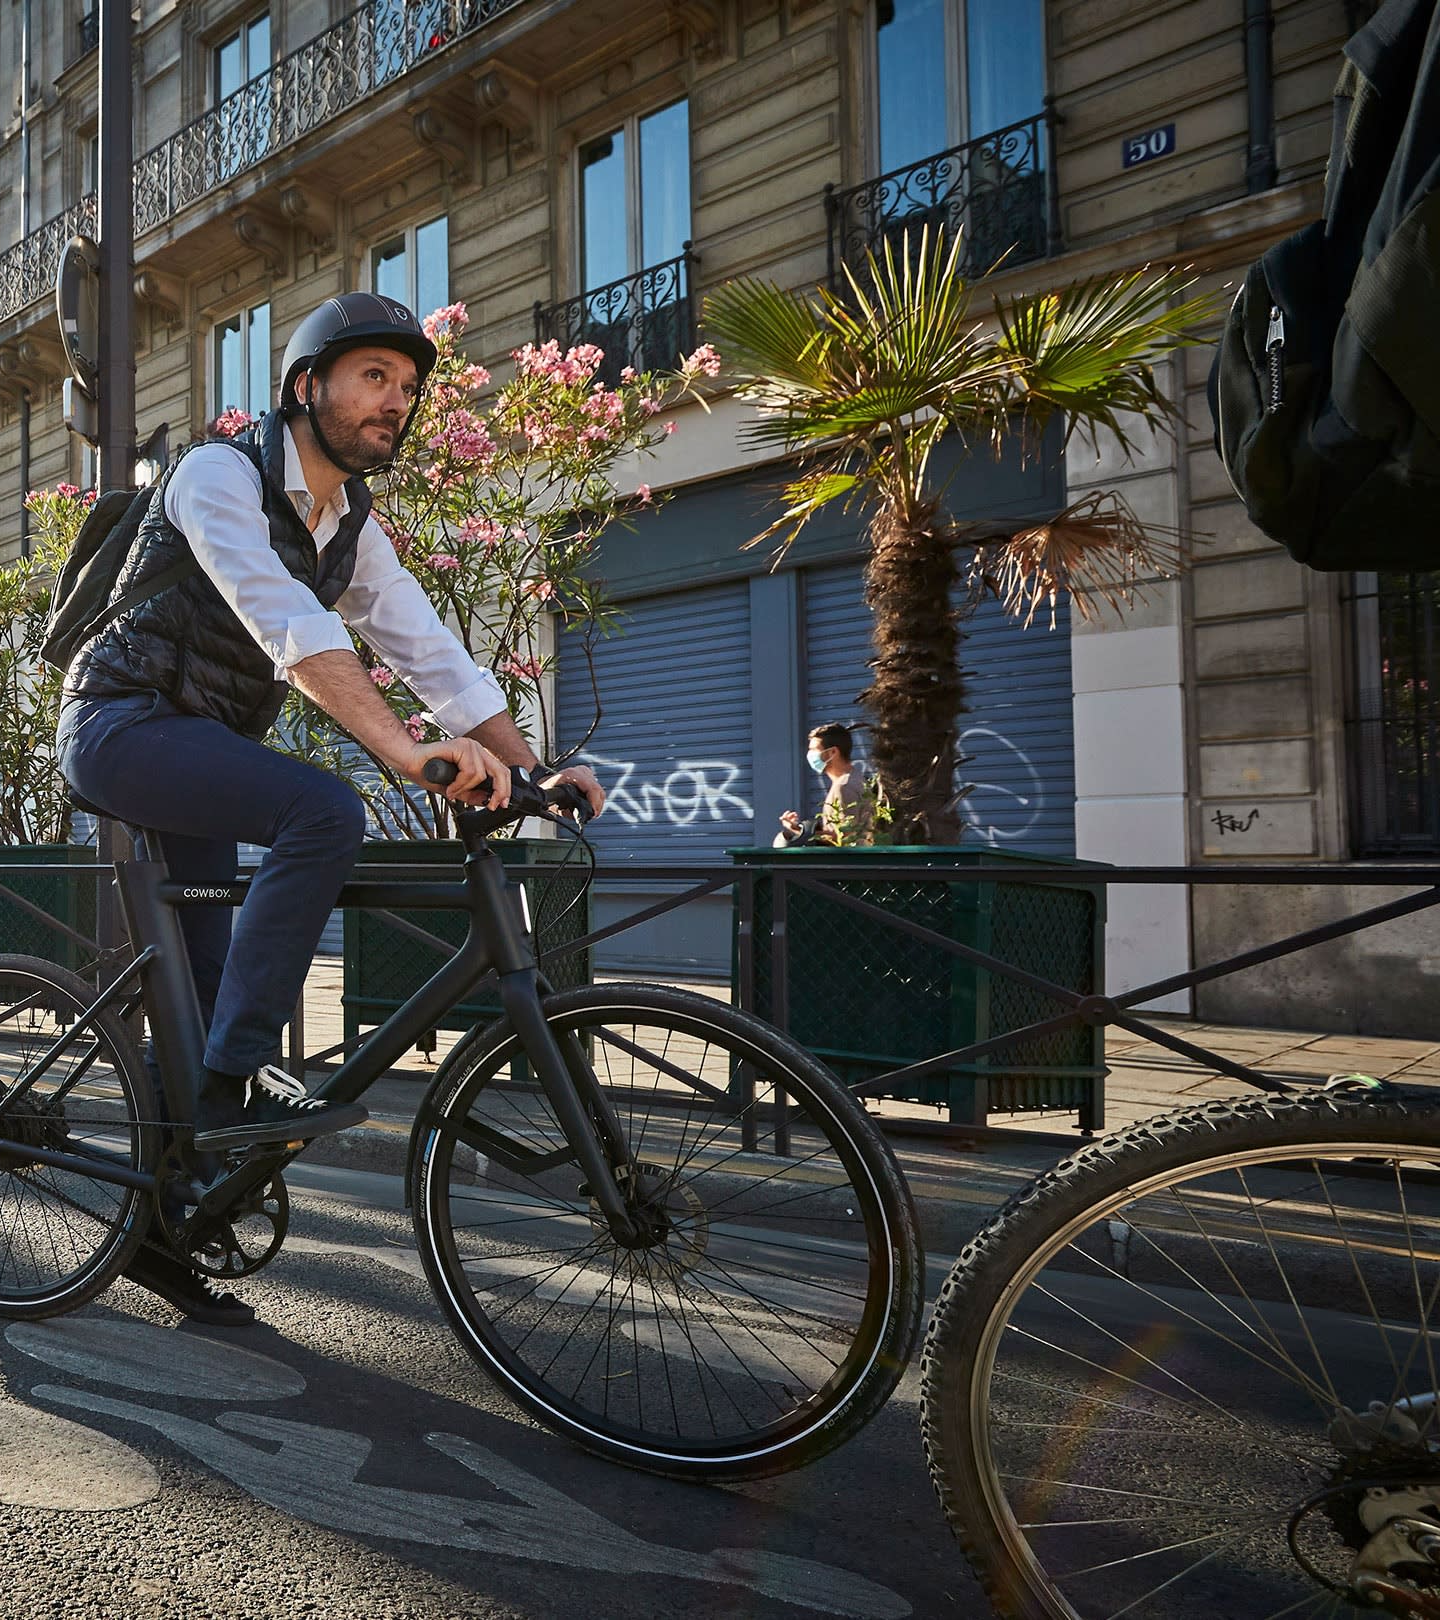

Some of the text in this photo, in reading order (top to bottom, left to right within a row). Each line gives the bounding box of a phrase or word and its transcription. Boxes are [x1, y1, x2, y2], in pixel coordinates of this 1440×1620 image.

[1130, 130, 1167, 161] 50
[183, 888, 231, 898] COWBOY.
[456, 1065, 474, 1087] PLUS
